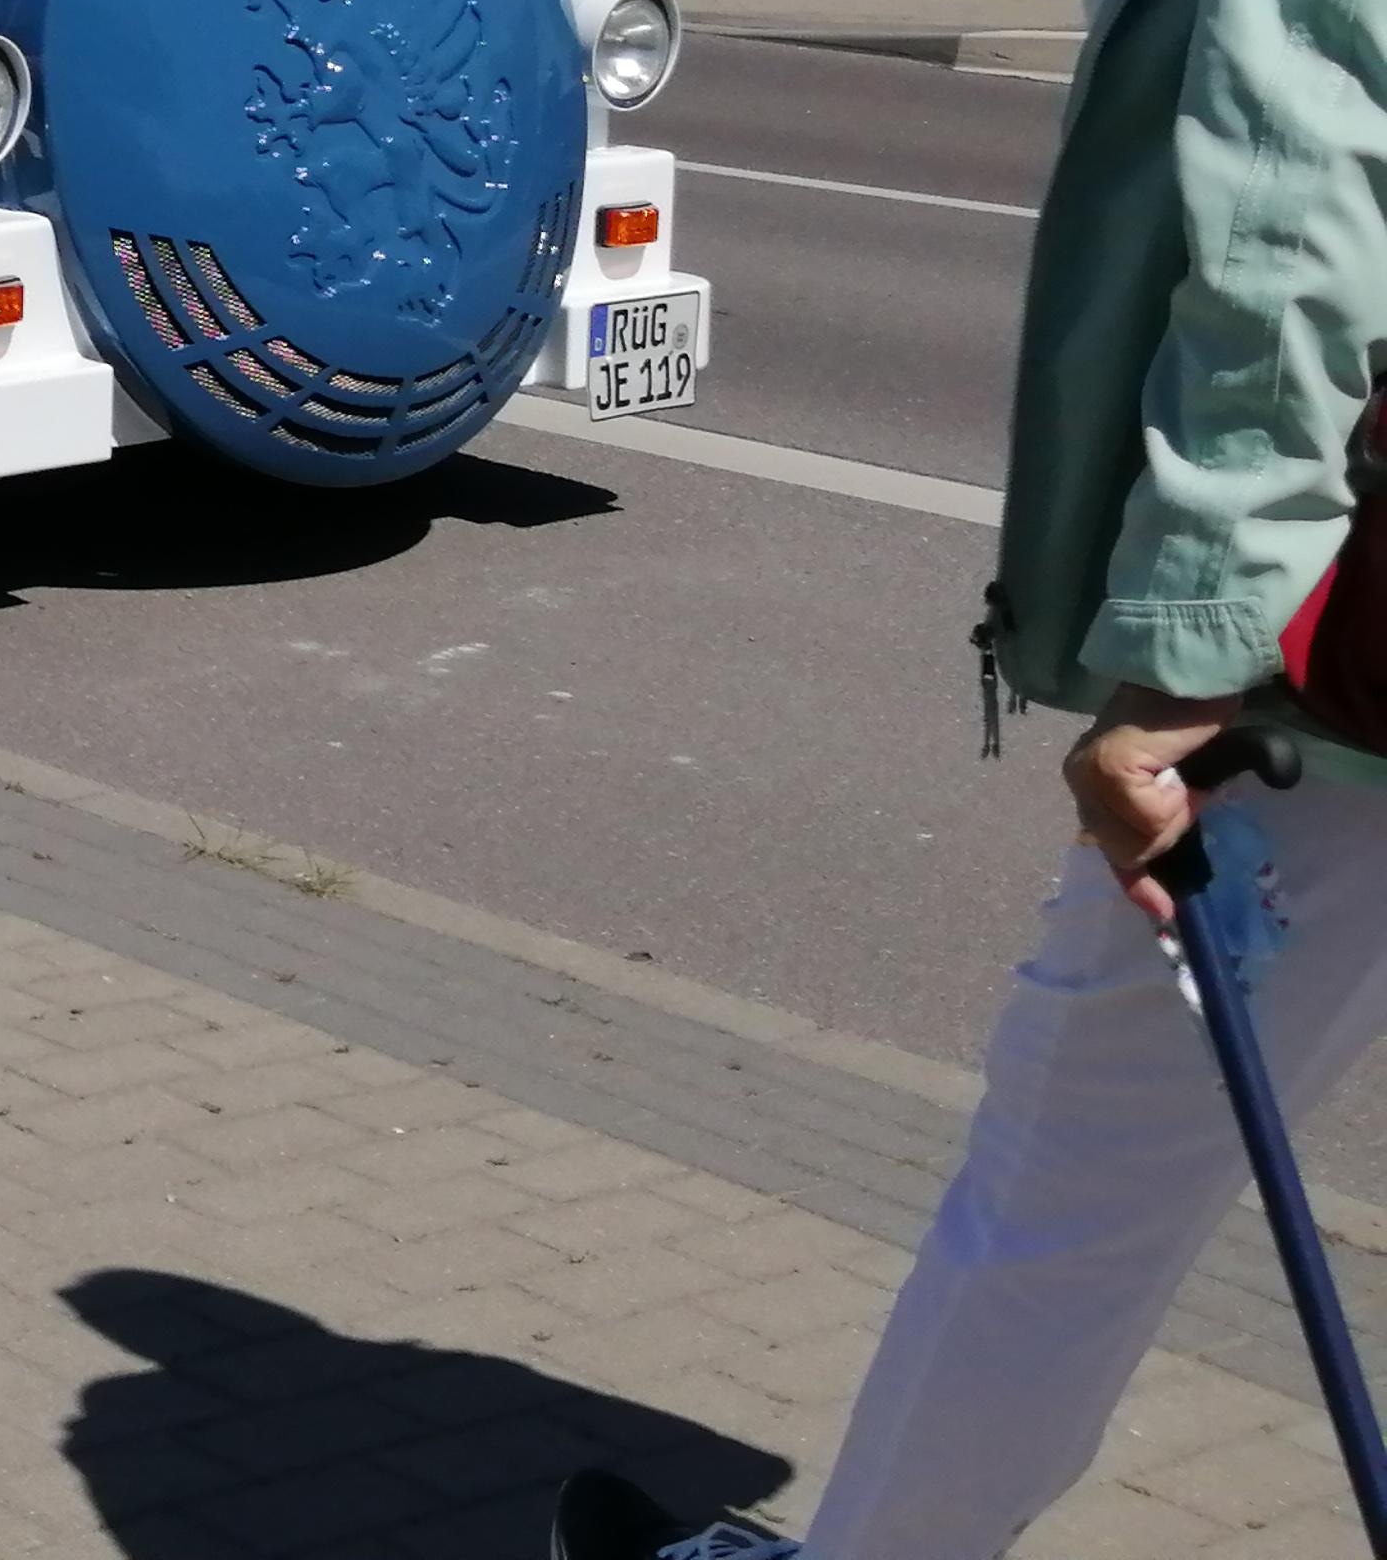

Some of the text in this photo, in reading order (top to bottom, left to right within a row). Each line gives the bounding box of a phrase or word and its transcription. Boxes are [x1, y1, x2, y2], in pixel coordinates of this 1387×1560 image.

[612, 303, 668, 354] RÜG
[595, 352, 692, 411] JE 119
